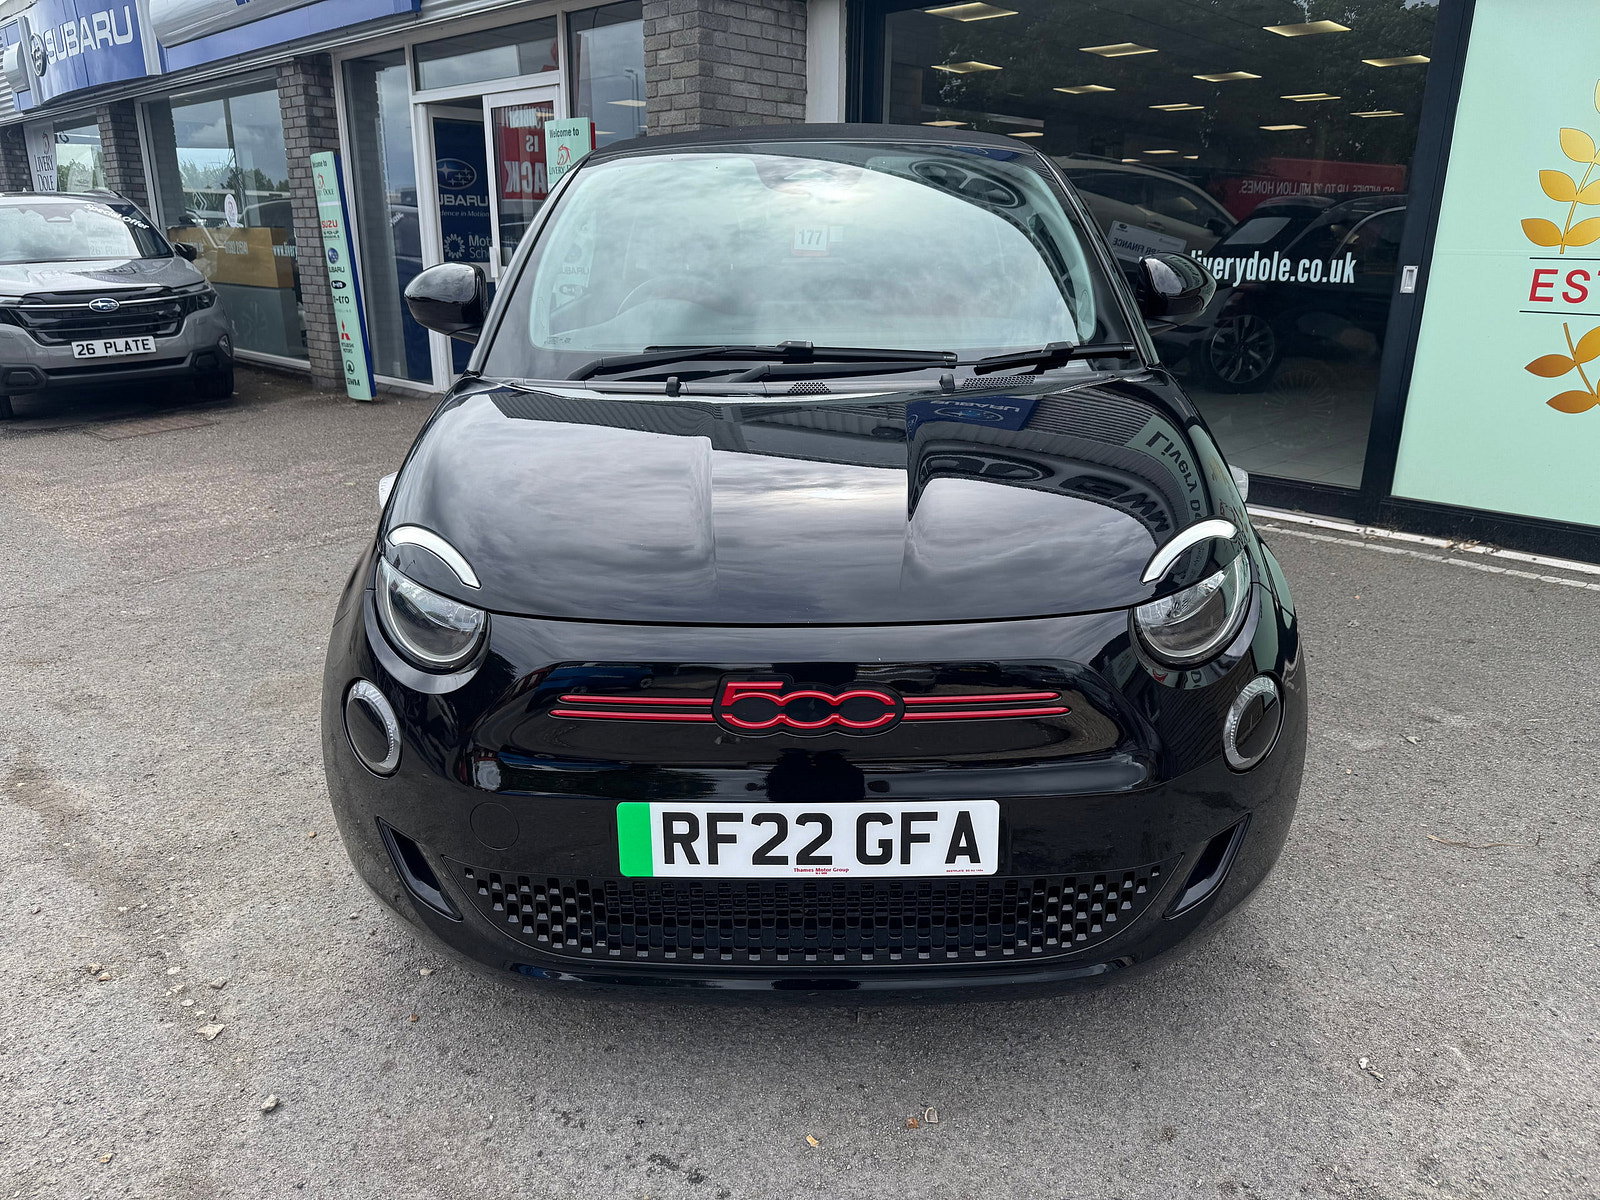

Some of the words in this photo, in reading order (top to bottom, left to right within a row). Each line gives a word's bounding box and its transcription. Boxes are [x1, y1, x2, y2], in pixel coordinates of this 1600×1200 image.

[44, 5, 133, 65] SUBARU
[549, 128, 571, 138] Welcome
[573, 127, 579, 136] to
[34, 154, 53, 173] LIVERY
[37, 174, 55, 192] DOLE
[440, 194, 488, 206] UBARU
[84, 203, 121, 219] Special
[122, 216, 149, 230] Offer
[799, 229, 822, 245] 177
[1529, 268, 1600, 304] ES
[76, 343, 96, 356] 26
[104, 339, 151, 354] PLATE
[721, 682, 896, 729] 500
[662, 811, 833, 866] RF22
[856, 811, 981, 866] GFA
